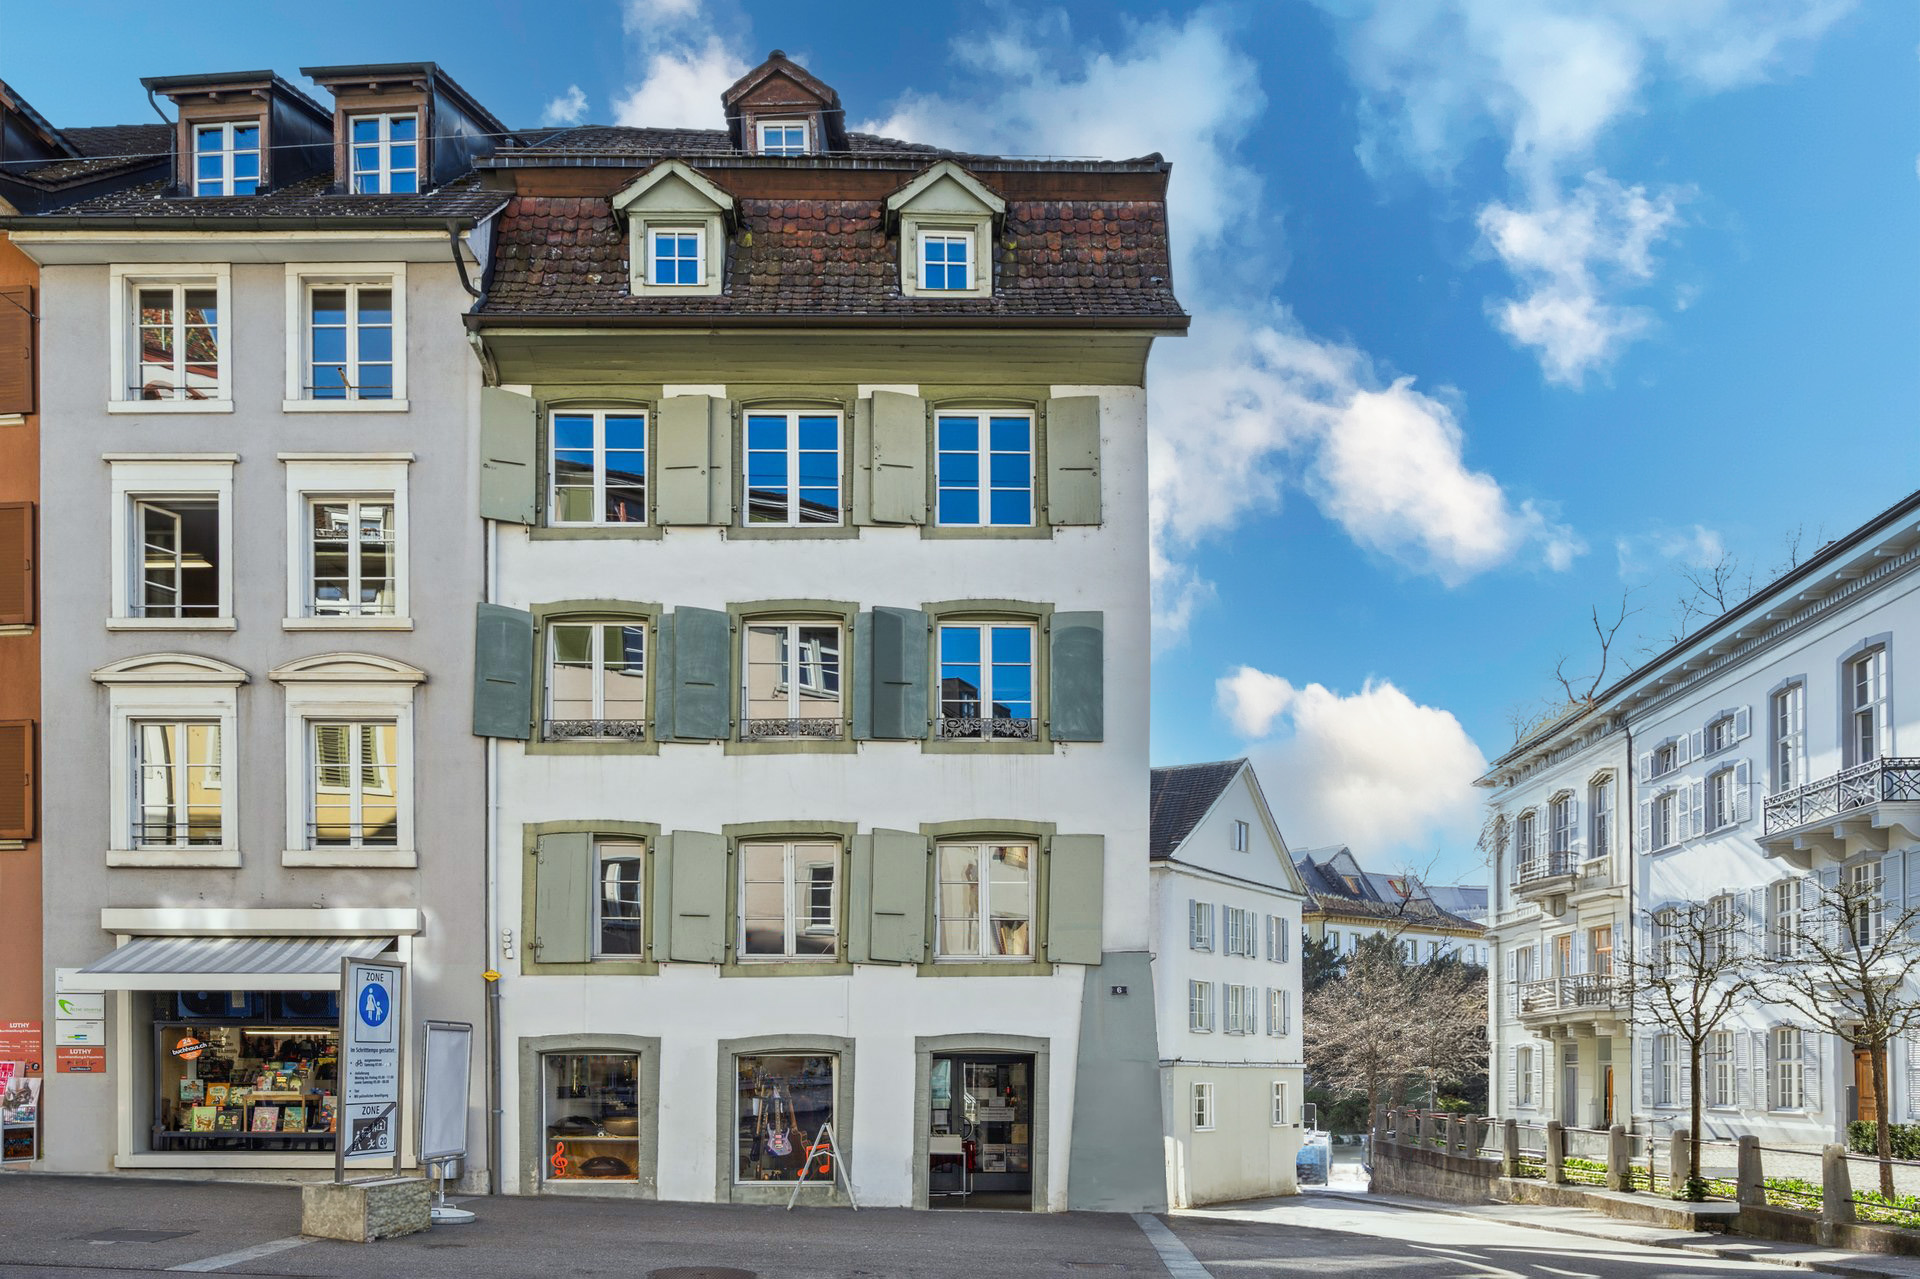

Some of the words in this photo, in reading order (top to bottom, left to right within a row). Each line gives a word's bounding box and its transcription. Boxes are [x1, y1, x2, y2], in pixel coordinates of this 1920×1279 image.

[366, 972, 384, 982] ZONE
[172, 1043, 208, 1056] buchhaus.ch
[362, 1105, 380, 1116] ZONE
[380, 1136, 388, 1146] 20
